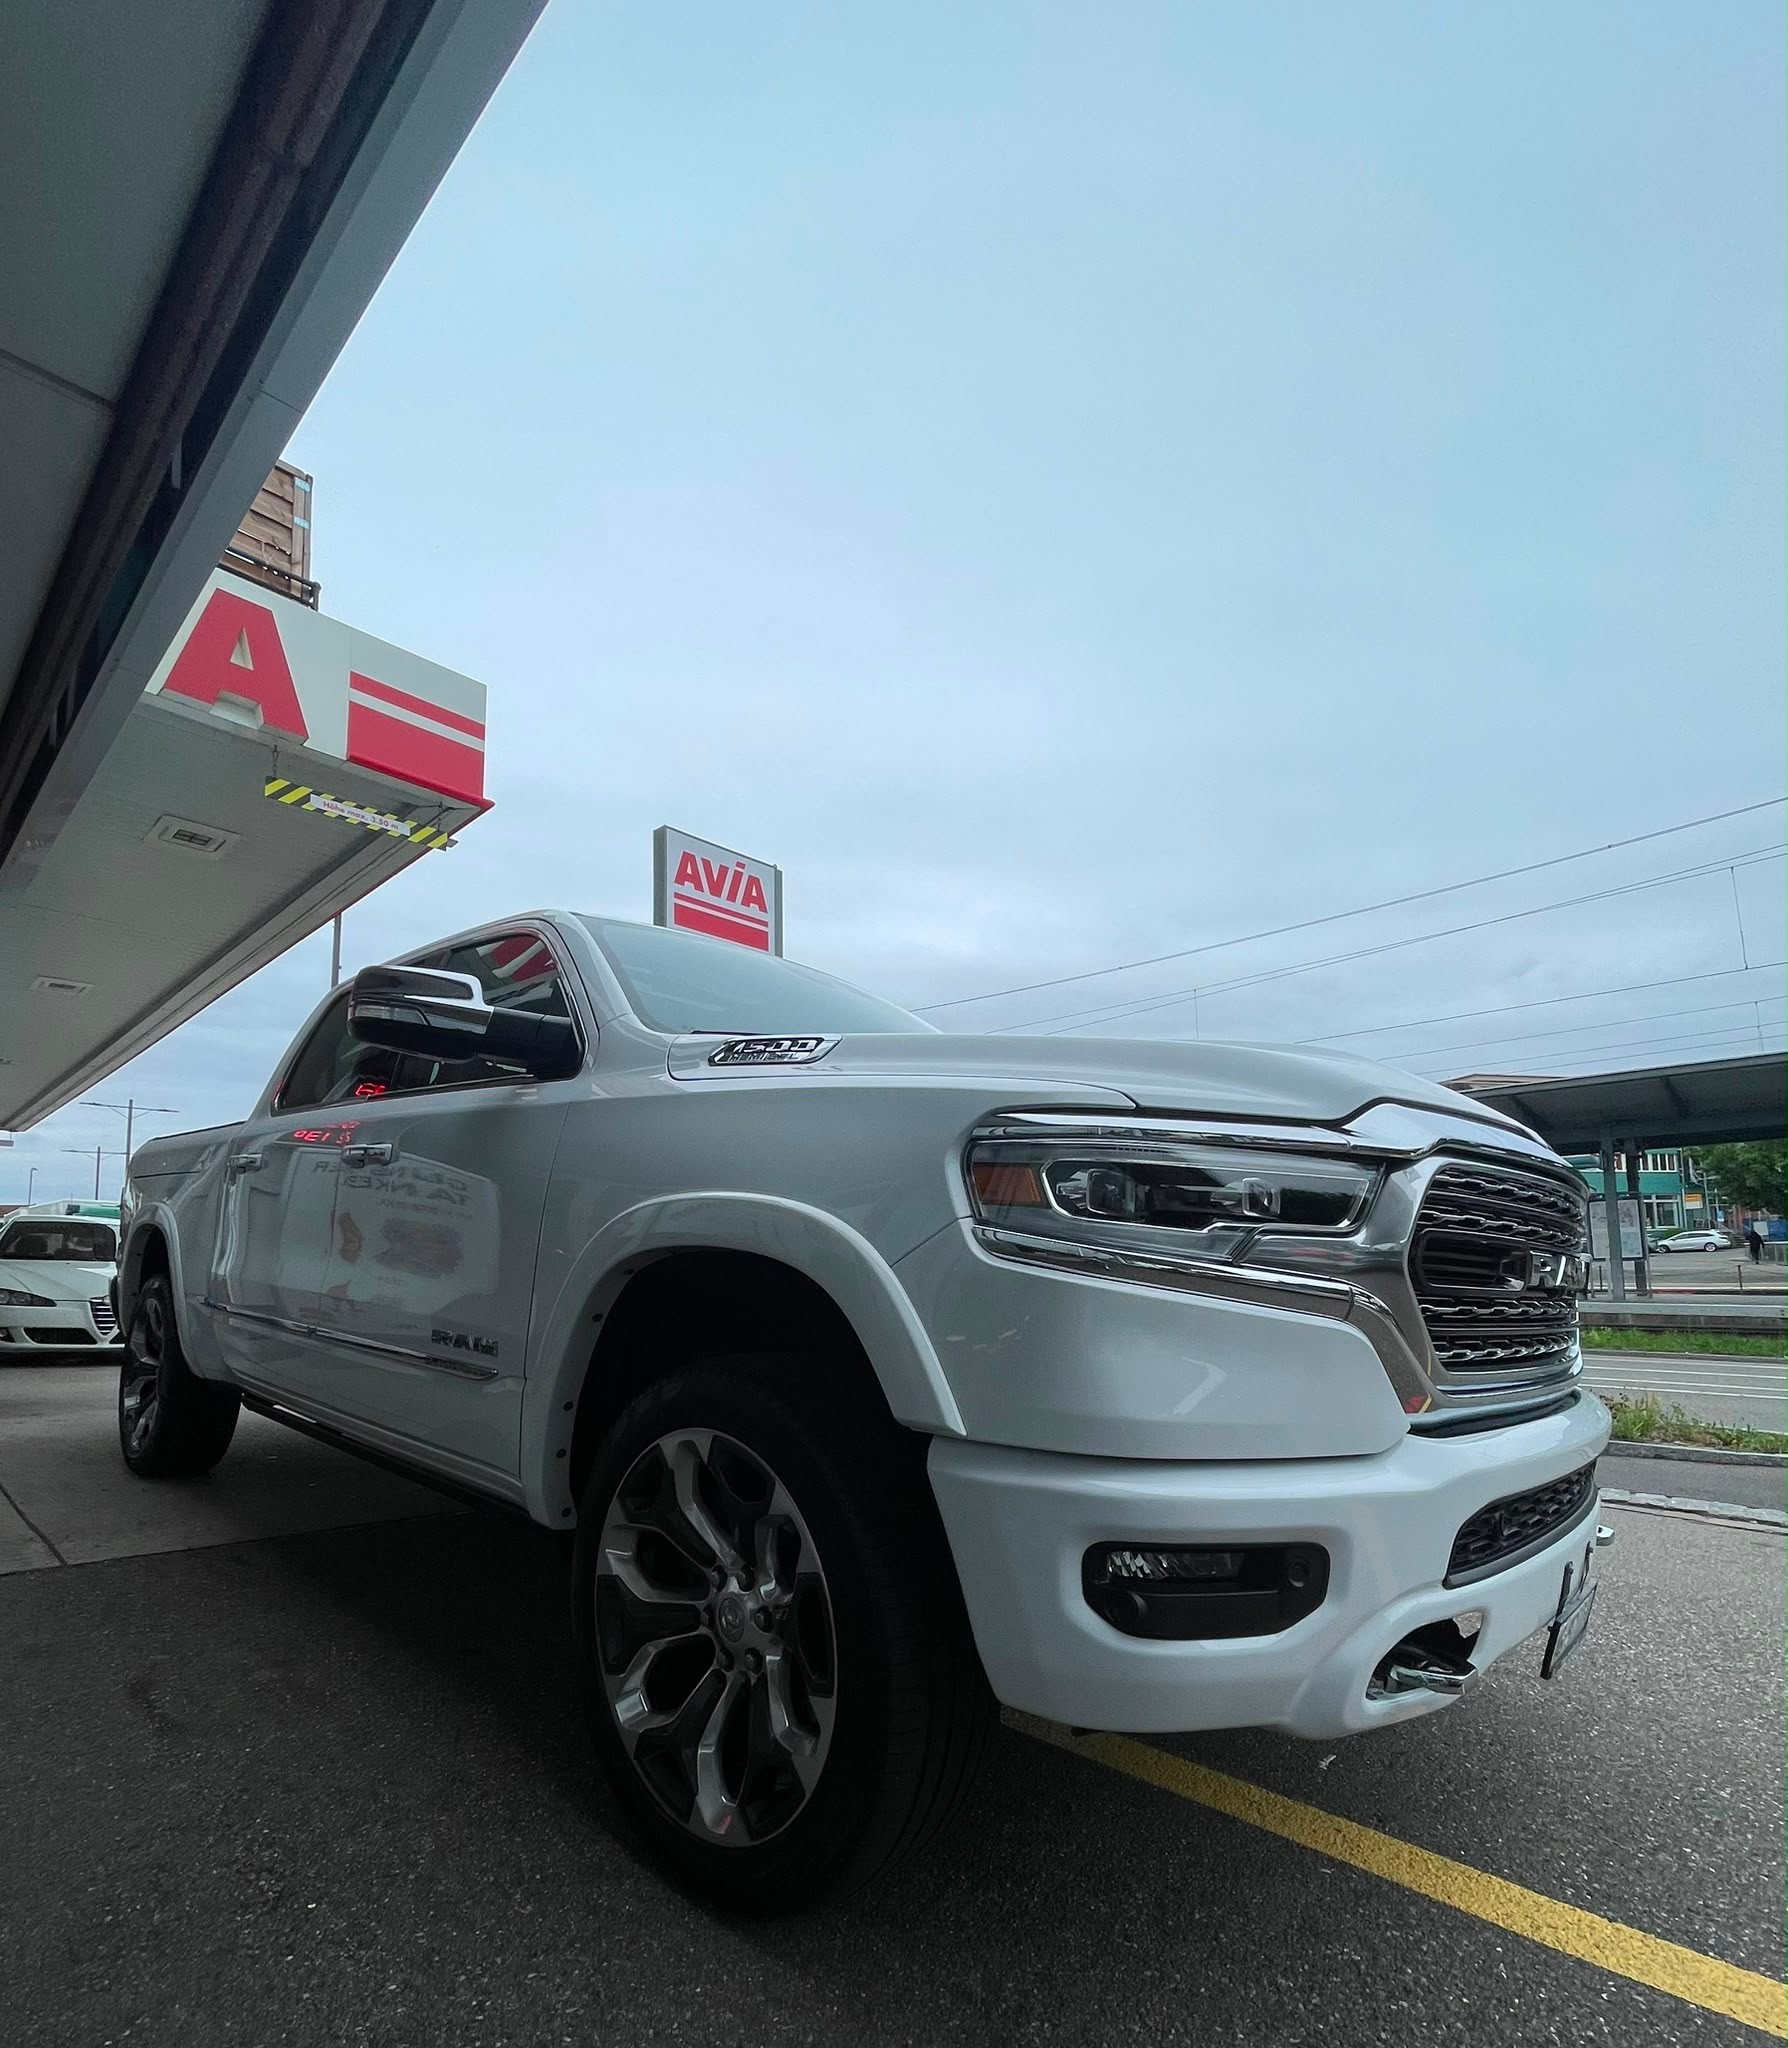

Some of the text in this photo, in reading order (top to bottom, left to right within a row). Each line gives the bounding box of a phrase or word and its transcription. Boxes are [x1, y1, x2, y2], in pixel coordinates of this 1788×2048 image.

[323, 801, 345, 813] Höhe
[347, 810, 369, 821] max.
[370, 815, 390, 828] 3.50
[732, 1040, 819, 1053] 1500
[431, 1328, 499, 1358] RAM
